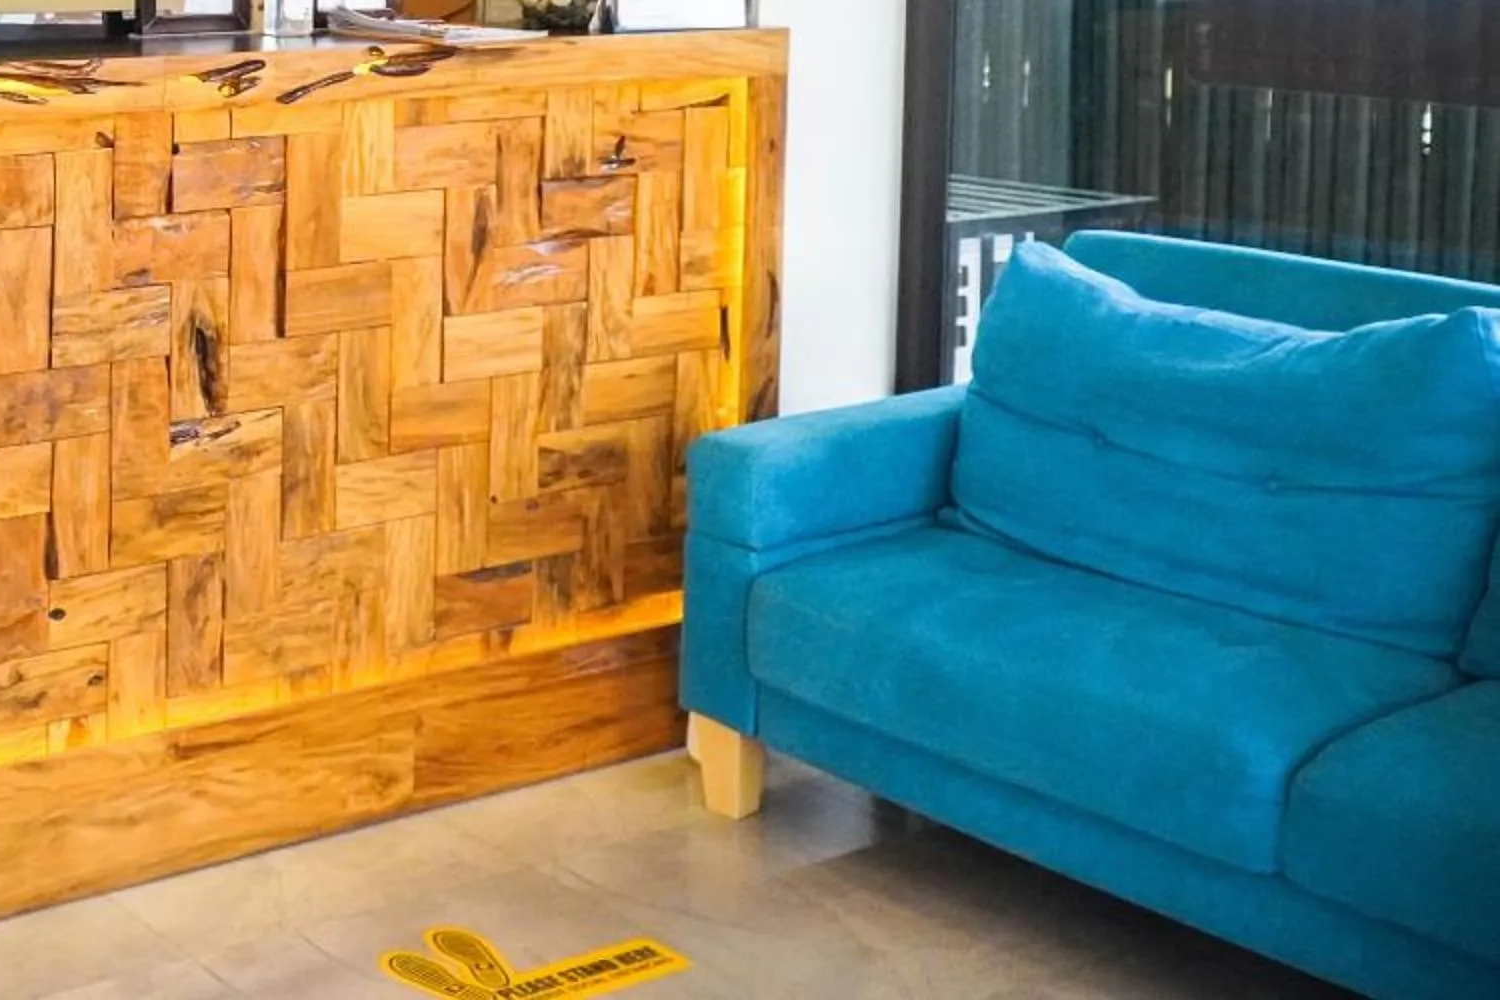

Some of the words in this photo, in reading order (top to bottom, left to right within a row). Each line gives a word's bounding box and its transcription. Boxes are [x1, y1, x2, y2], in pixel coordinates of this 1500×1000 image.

[498, 974, 564, 1000] PLEASE
[557, 959, 620, 983] STAND
[612, 946, 660, 966] HERE
